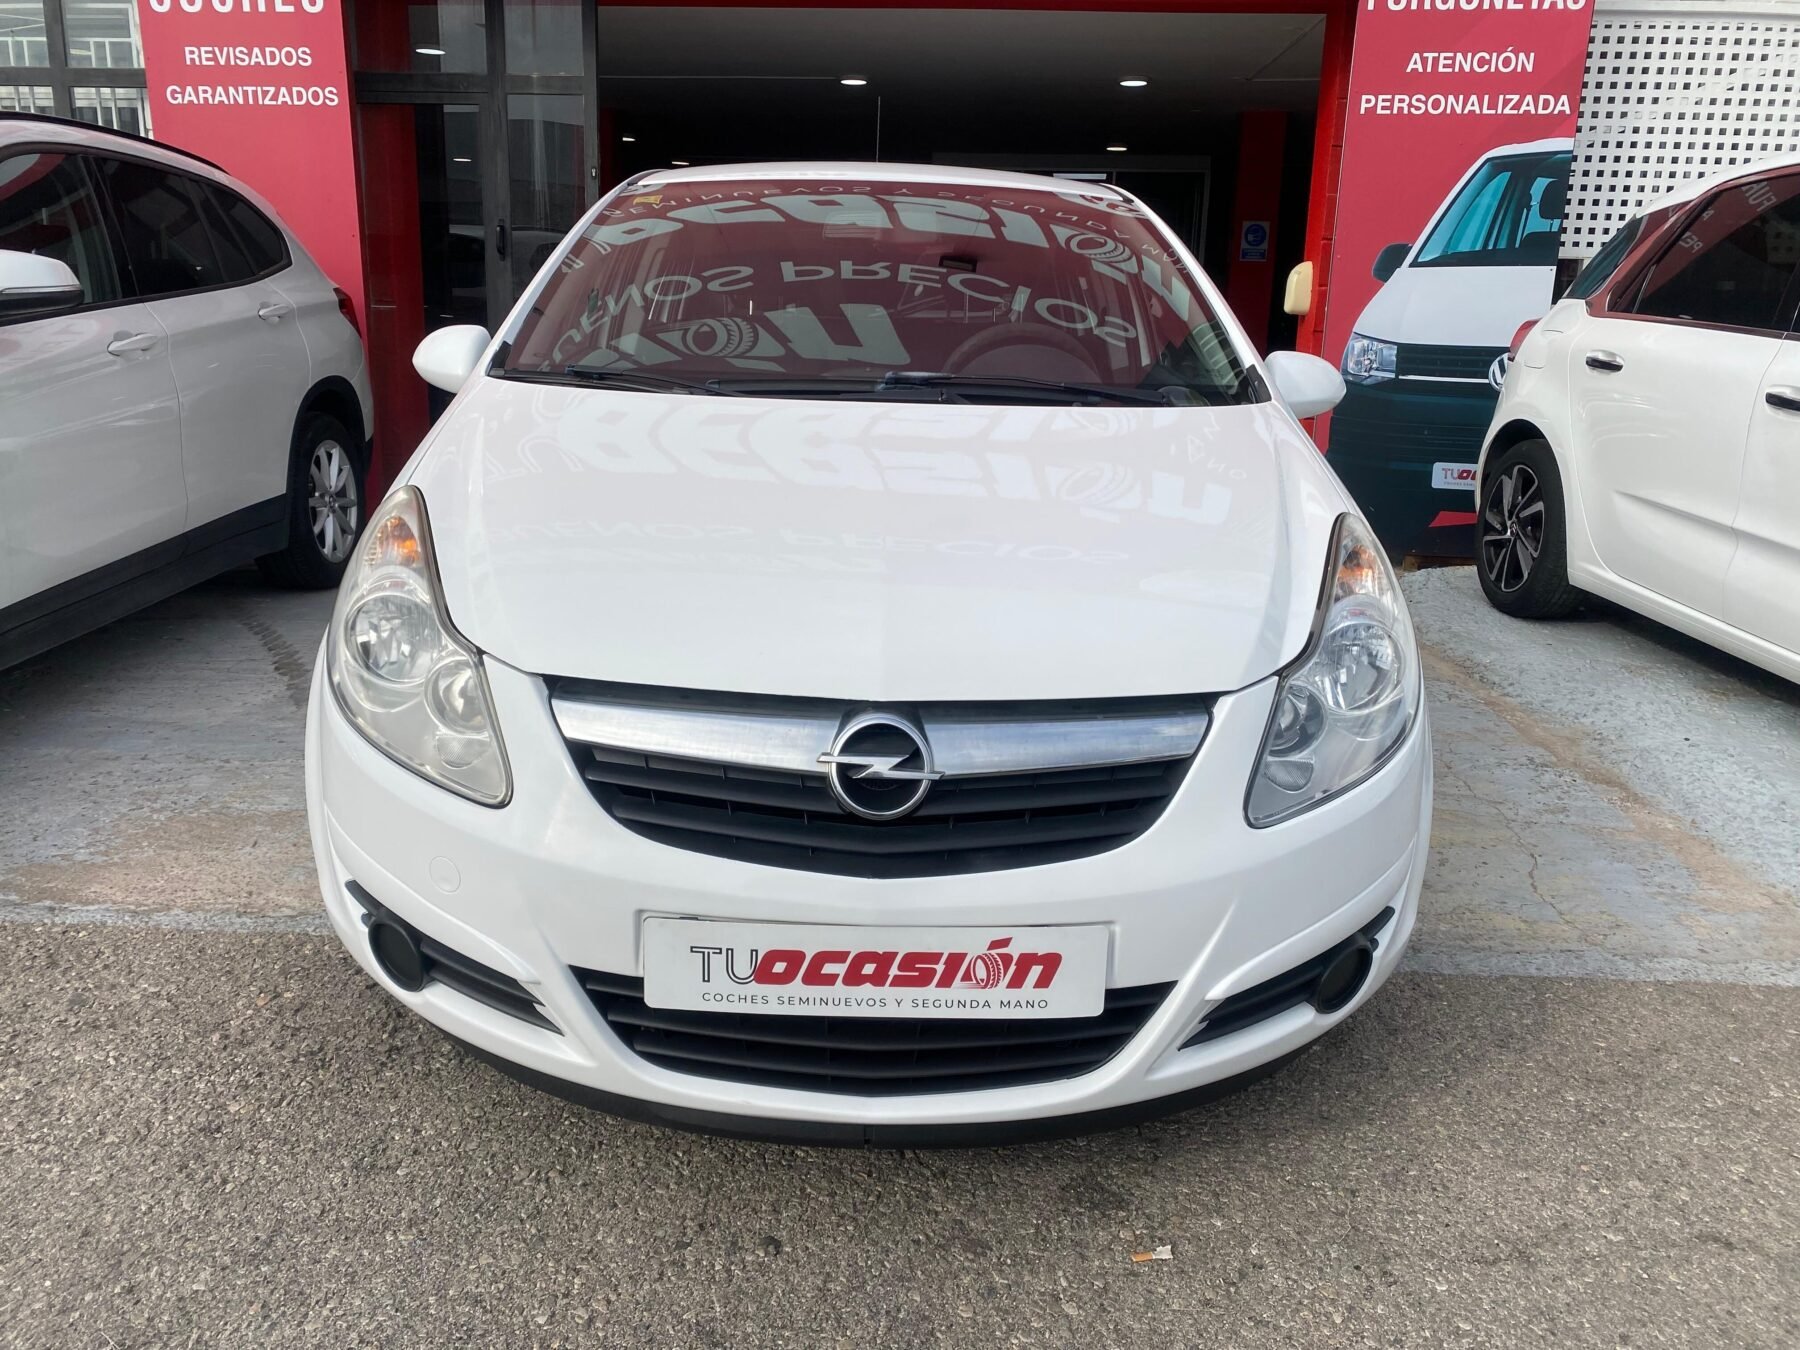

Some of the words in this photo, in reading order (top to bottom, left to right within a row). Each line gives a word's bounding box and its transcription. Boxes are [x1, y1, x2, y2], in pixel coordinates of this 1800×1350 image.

[184, 46, 312, 67] REVISADOS
[1406, 47, 1535, 73] ATENCIÓN
[166, 85, 339, 106] GARANTIZADOS
[1360, 94, 1571, 115] PERSONALIZADA
[702, 992, 769, 1005] COCHES
[777, 995, 887, 1008] SEMINUEVOS
[894, 998, 904, 1008] Y
[911, 998, 992, 1010] SEGUNDA
[999, 999, 1049, 1010] MANO
